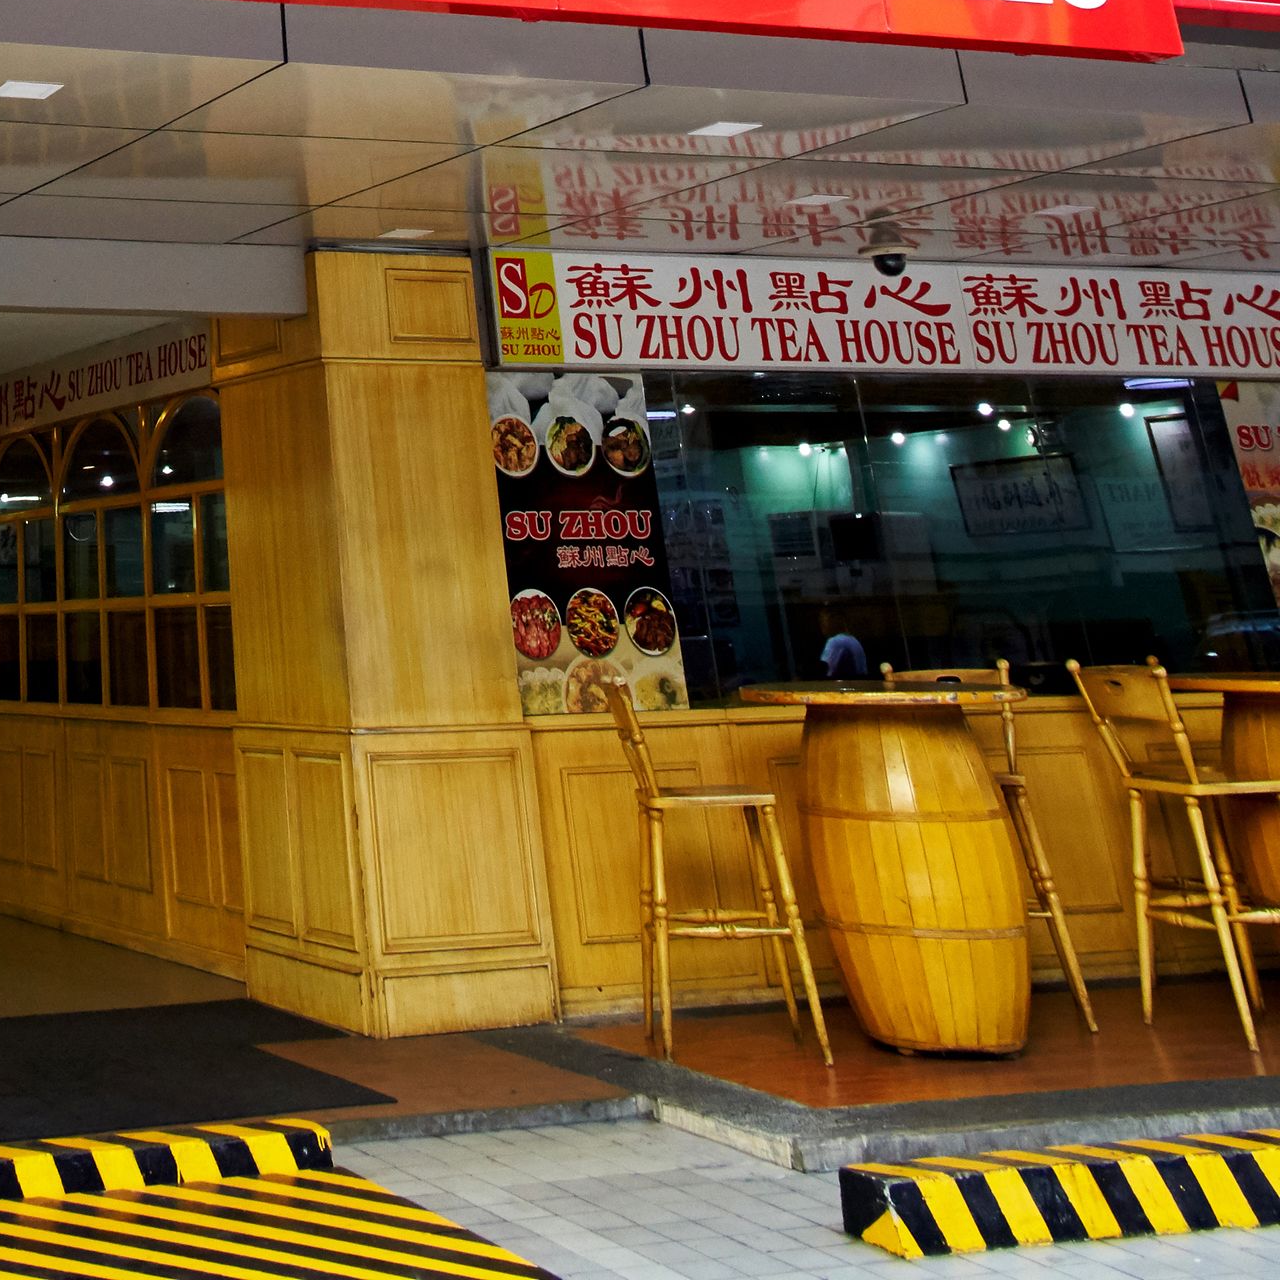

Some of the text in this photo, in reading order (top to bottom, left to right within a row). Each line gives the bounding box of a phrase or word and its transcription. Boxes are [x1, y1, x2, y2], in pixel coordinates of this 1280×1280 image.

[564, 262, 952, 317] 蘇州點心
[962, 273, 1280, 322] 蘇州點心
[500, 326, 561, 342] 蘇州點心
[501, 343, 561, 357] SU ZHOU
[572, 312, 961, 365] SU ZHOU TEA HOUSE
[972, 319, 1019, 365] SU
[1026, 321, 1121, 366] ZHOU
[1126, 324, 1199, 367] TEA
[68, 368, 85, 402] SU
[87, 357, 123, 397] ZHOU
[126, 349, 154, 387] TEA
[157, 333, 208, 380] HOUSE
[1236, 425, 1273, 450] SU
[505, 510, 652, 541] SU ZHOU
[556, 544, 655, 568] 蘇州點心
